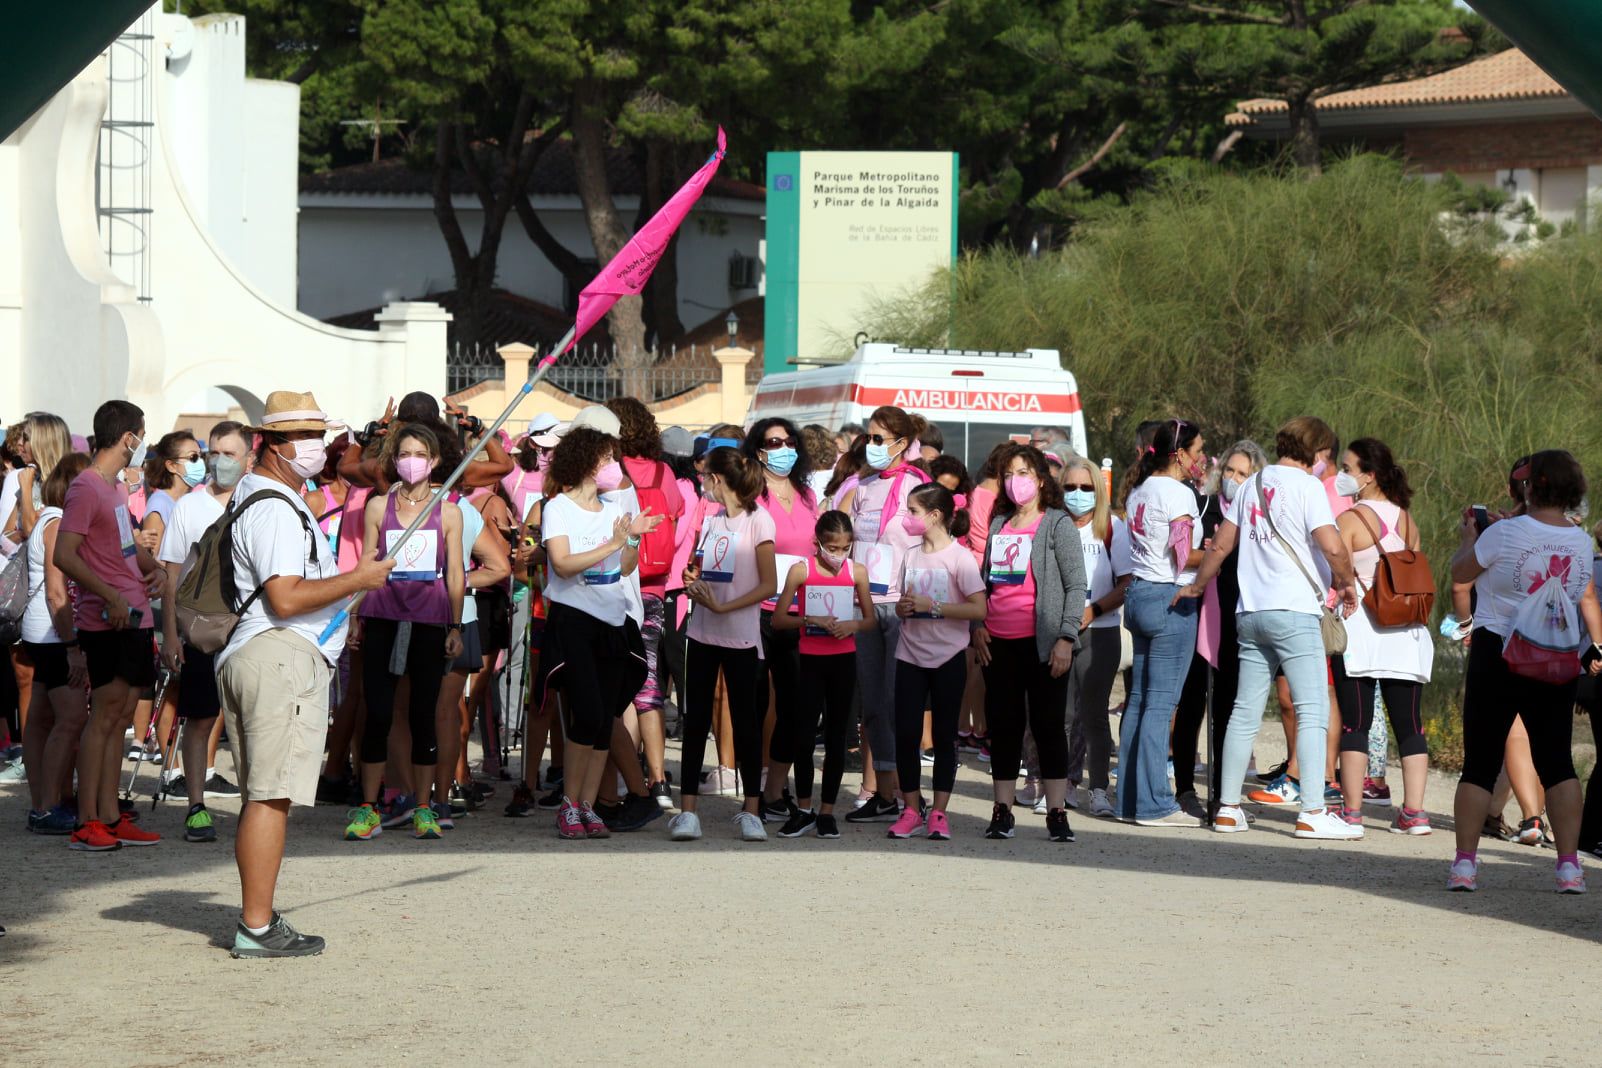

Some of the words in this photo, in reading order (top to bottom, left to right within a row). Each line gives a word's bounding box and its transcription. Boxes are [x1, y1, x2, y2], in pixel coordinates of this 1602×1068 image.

[814, 171, 853, 183] Parque
[859, 171, 940, 183] Metropolitano
[814, 185, 859, 194] Marisma
[863, 185, 875, 194] de
[879, 185, 893, 194] los
[898, 184, 939, 194] Toruños
[813, 199, 819, 209] y
[825, 197, 855, 207] Pinar
[861, 198, 874, 207] de
[880, 198, 890, 207] la
[896, 198, 939, 209] Algaida
[892, 389, 1042, 411] AMBULANCIA
